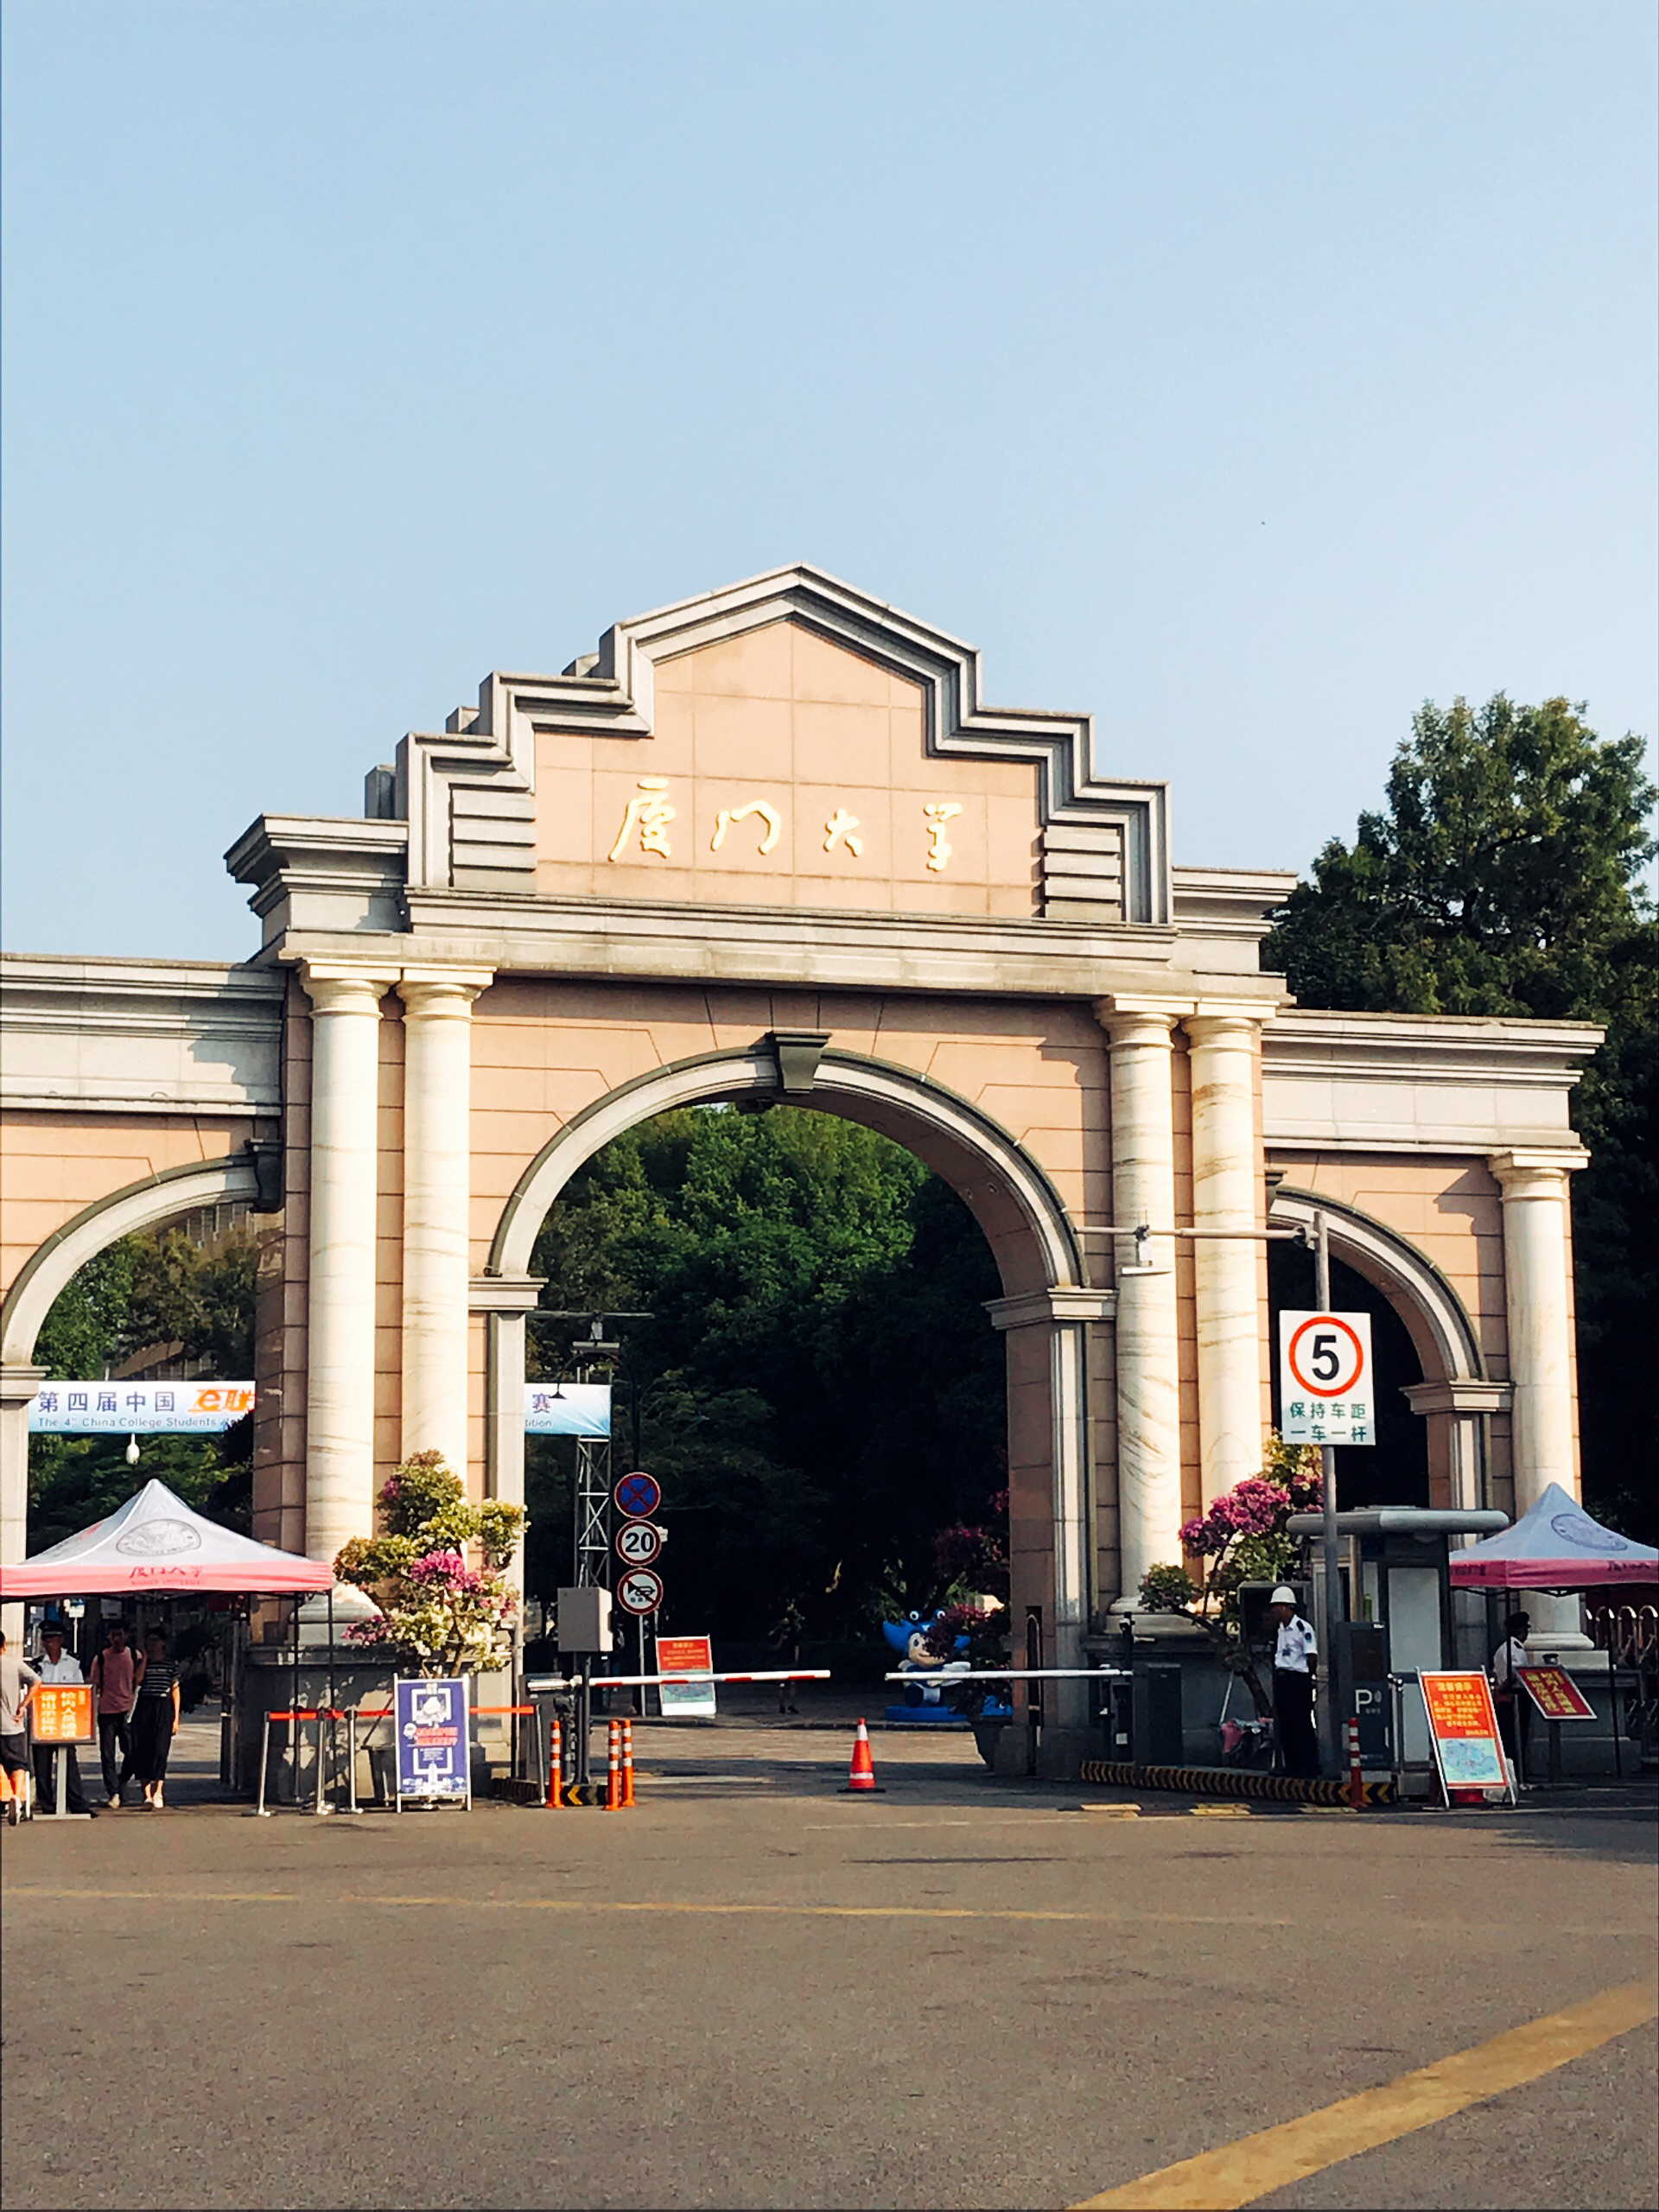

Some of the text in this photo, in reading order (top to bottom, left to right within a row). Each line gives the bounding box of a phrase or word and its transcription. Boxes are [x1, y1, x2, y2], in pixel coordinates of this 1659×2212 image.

[1312, 1335, 1339, 1381] 5
[38, 1391, 175, 1413] 第四届中国
[1290, 1402, 1366, 1420] 保持车距
[38, 1417, 60, 1427] The
[82, 1417, 116, 1427] China
[119, 1417, 162, 1428] College
[1290, 1425, 1368, 1441] 一车一杆
[625, 1532, 655, 1553] 20
[1355, 1689, 1373, 1713] P
